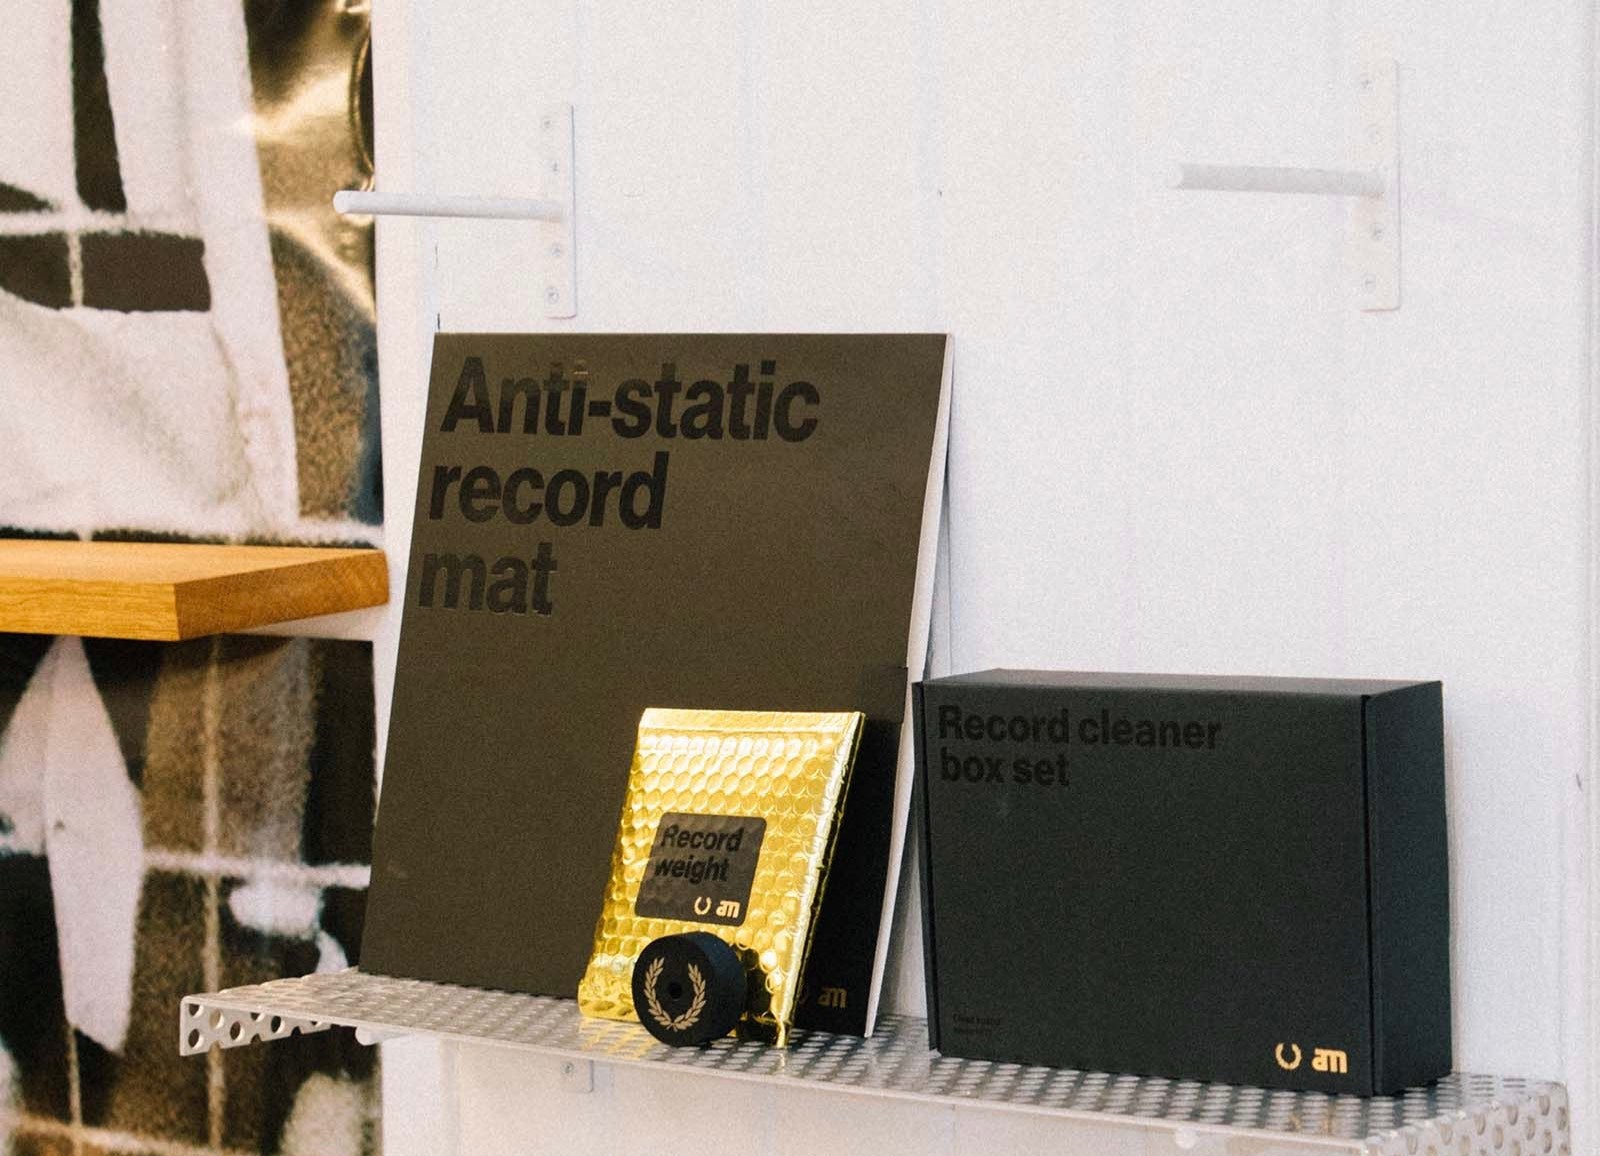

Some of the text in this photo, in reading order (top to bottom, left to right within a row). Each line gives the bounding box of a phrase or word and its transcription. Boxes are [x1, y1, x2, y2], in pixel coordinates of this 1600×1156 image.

[440, 357, 820, 442] Anti-static
[429, 451, 669, 530] record
[418, 542, 557, 617] mat
[938, 704, 1222, 749] Record cleaner
[940, 747, 1070, 787] box set
[660, 824, 744, 852] Record
[654, 855, 730, 885] weight
